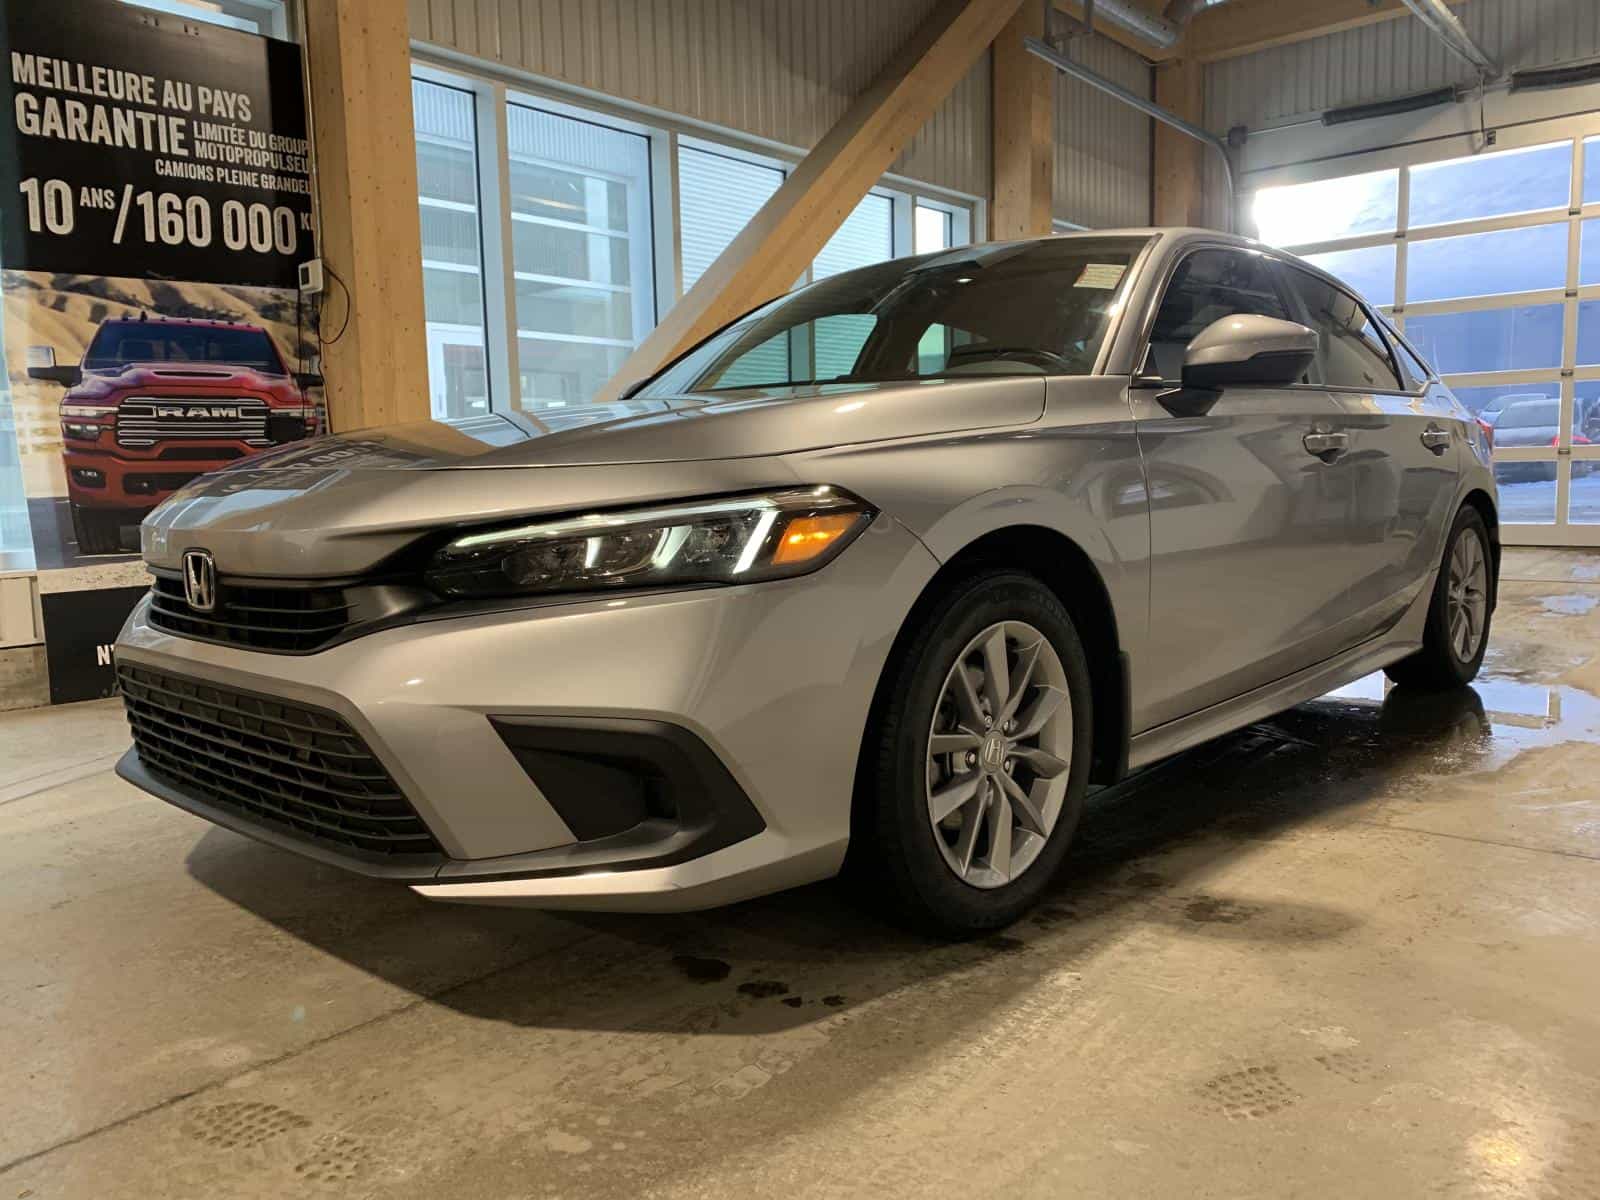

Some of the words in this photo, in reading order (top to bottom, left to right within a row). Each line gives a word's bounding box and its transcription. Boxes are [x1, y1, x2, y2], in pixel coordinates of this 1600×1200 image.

[11, 51, 157, 106] MEILLEURE
[162, 79, 193, 112] AU
[198, 85, 251, 122] PAYS
[15, 92, 189, 157] GARANTIE
[193, 119, 247, 146] LIMITÉE
[249, 129, 266, 149] DU
[155, 158, 214, 182] CAMIONS
[216, 166, 260, 188] PLEINE
[19, 177, 75, 235] 10
[79, 186, 116, 211] ANS
[222, 199, 297, 255] 000
[157, 406, 237, 418] RAM
